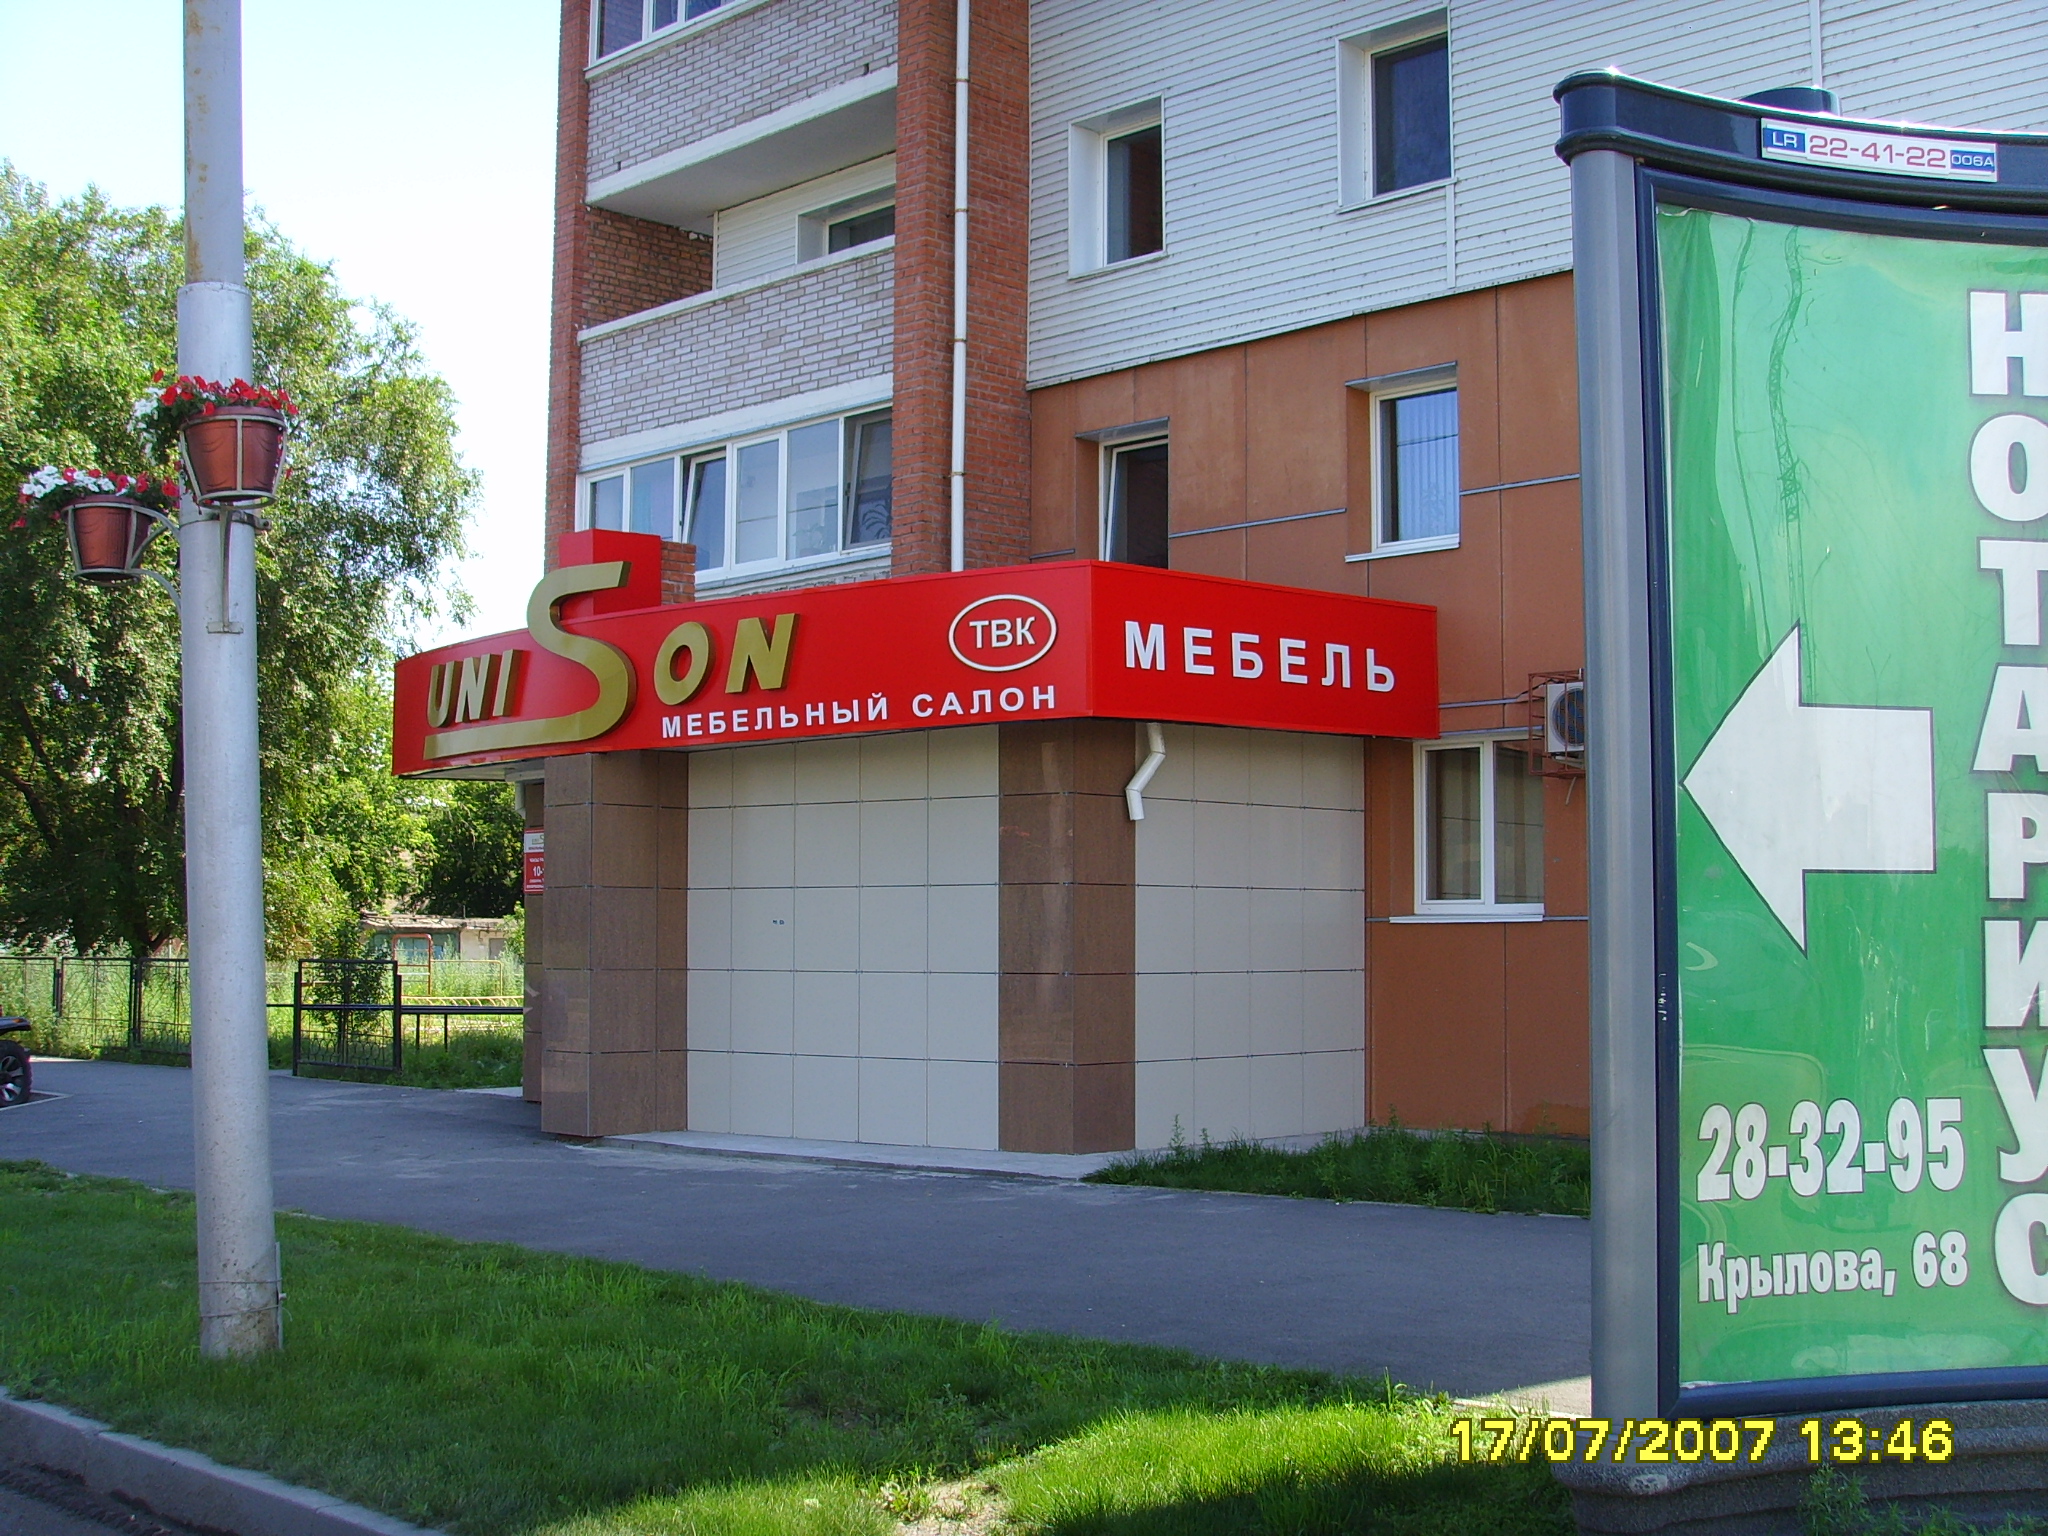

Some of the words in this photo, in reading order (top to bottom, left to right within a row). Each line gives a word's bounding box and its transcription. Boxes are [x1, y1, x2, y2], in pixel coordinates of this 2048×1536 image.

[1771, 131, 1798, 149] LR
[1809, 135, 1947, 168] 22-41-22
[968, 614, 1038, 649] ТВК
[1124, 620, 1396, 693] МЕБЕЛЬ
[661, 692, 889, 739] МЕБЕЛЬНЫЙ
[911, 685, 1056, 718] САЛОН
[1967, 288, 2048, 1306] НОТАРИУС
[1697, 1097, 1964, 1201] 28-32-95
[1697, 1240, 1897, 1315] Крылова,
[1912, 1230, 1969, 1289] 68
